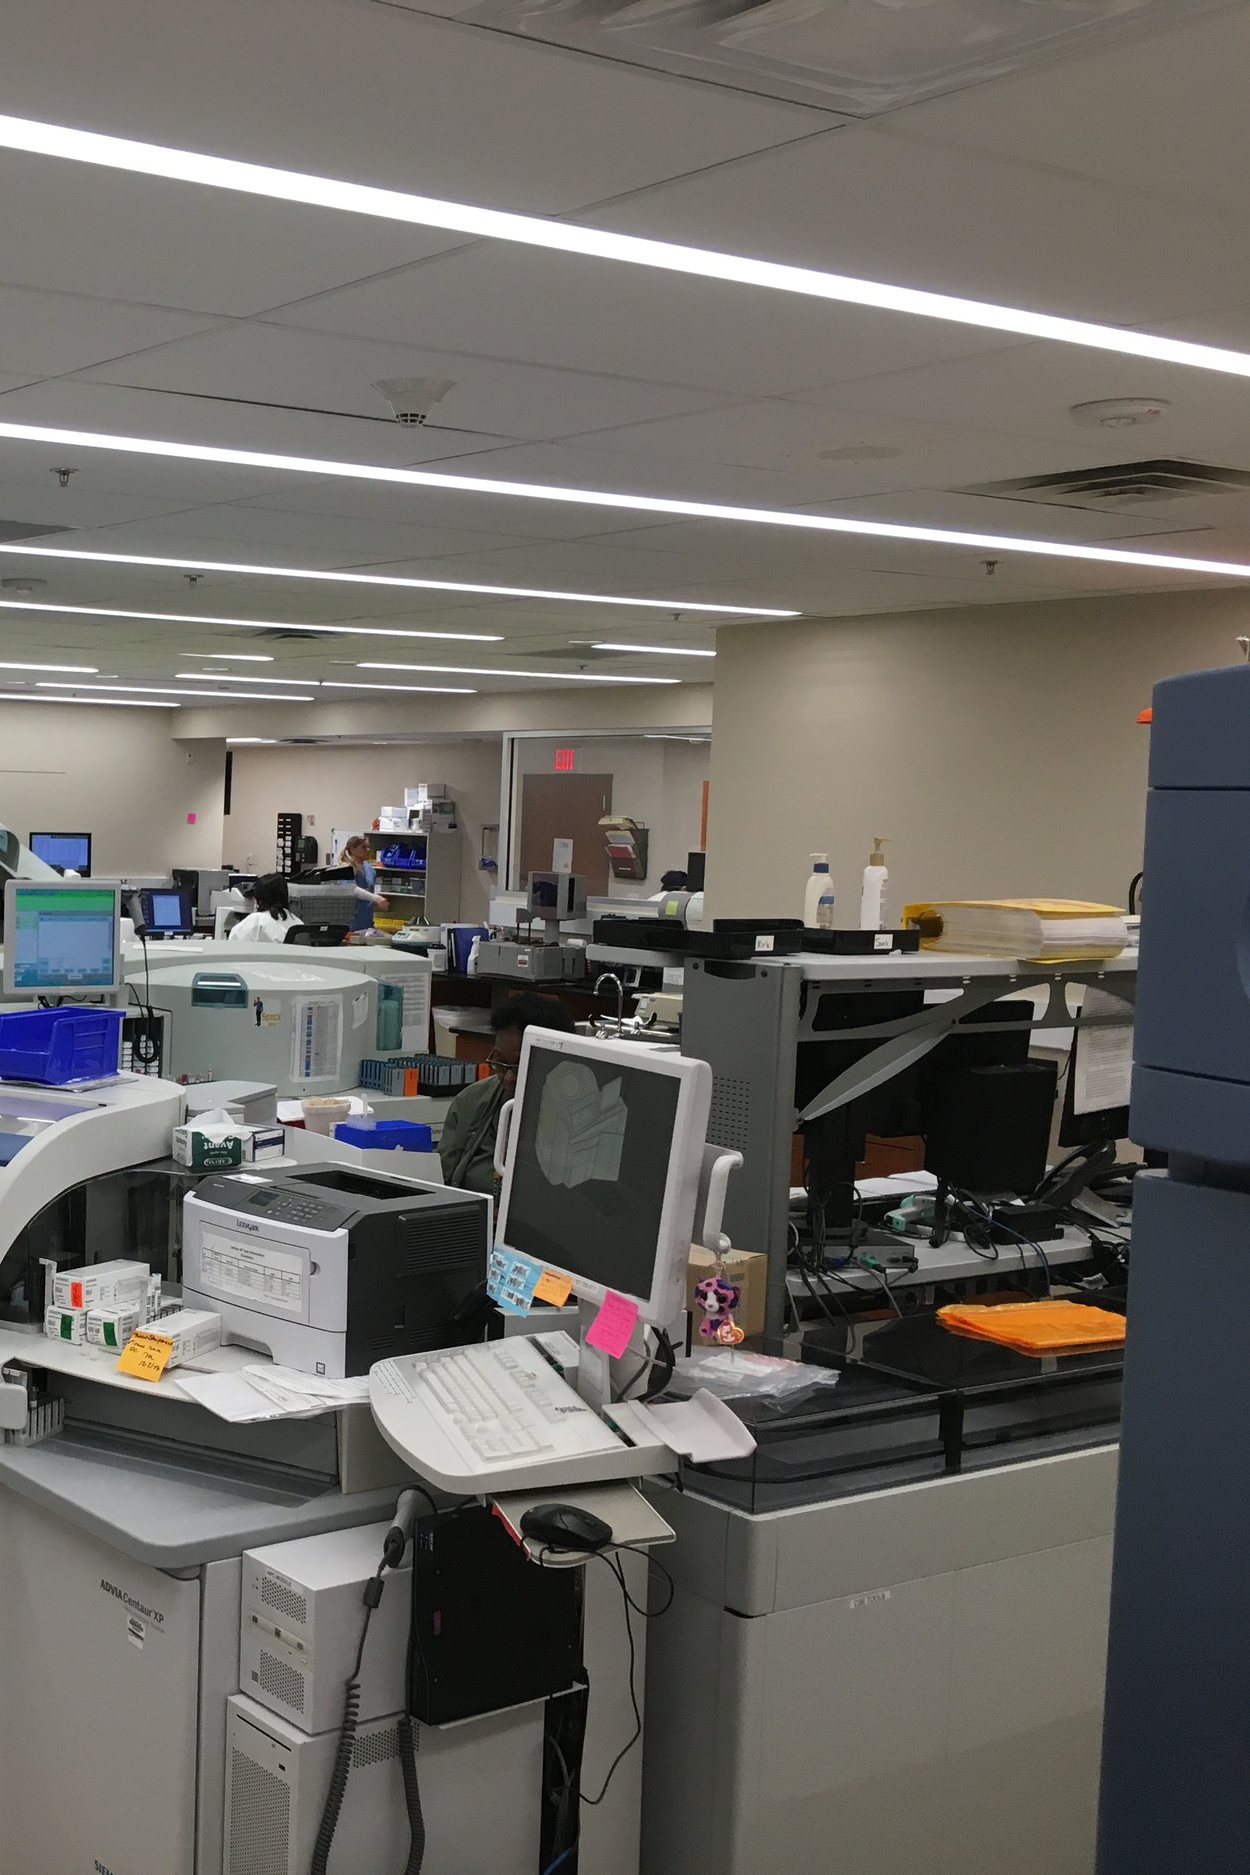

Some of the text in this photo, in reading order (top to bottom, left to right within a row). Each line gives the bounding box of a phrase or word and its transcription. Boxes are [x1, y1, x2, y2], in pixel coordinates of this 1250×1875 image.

[554, 749, 574, 770] EXIT
[100, 1579, 123, 1600] ADVIA
[122, 1592, 153, 1617] Centaur
[153, 1608, 165, 1624] XP
